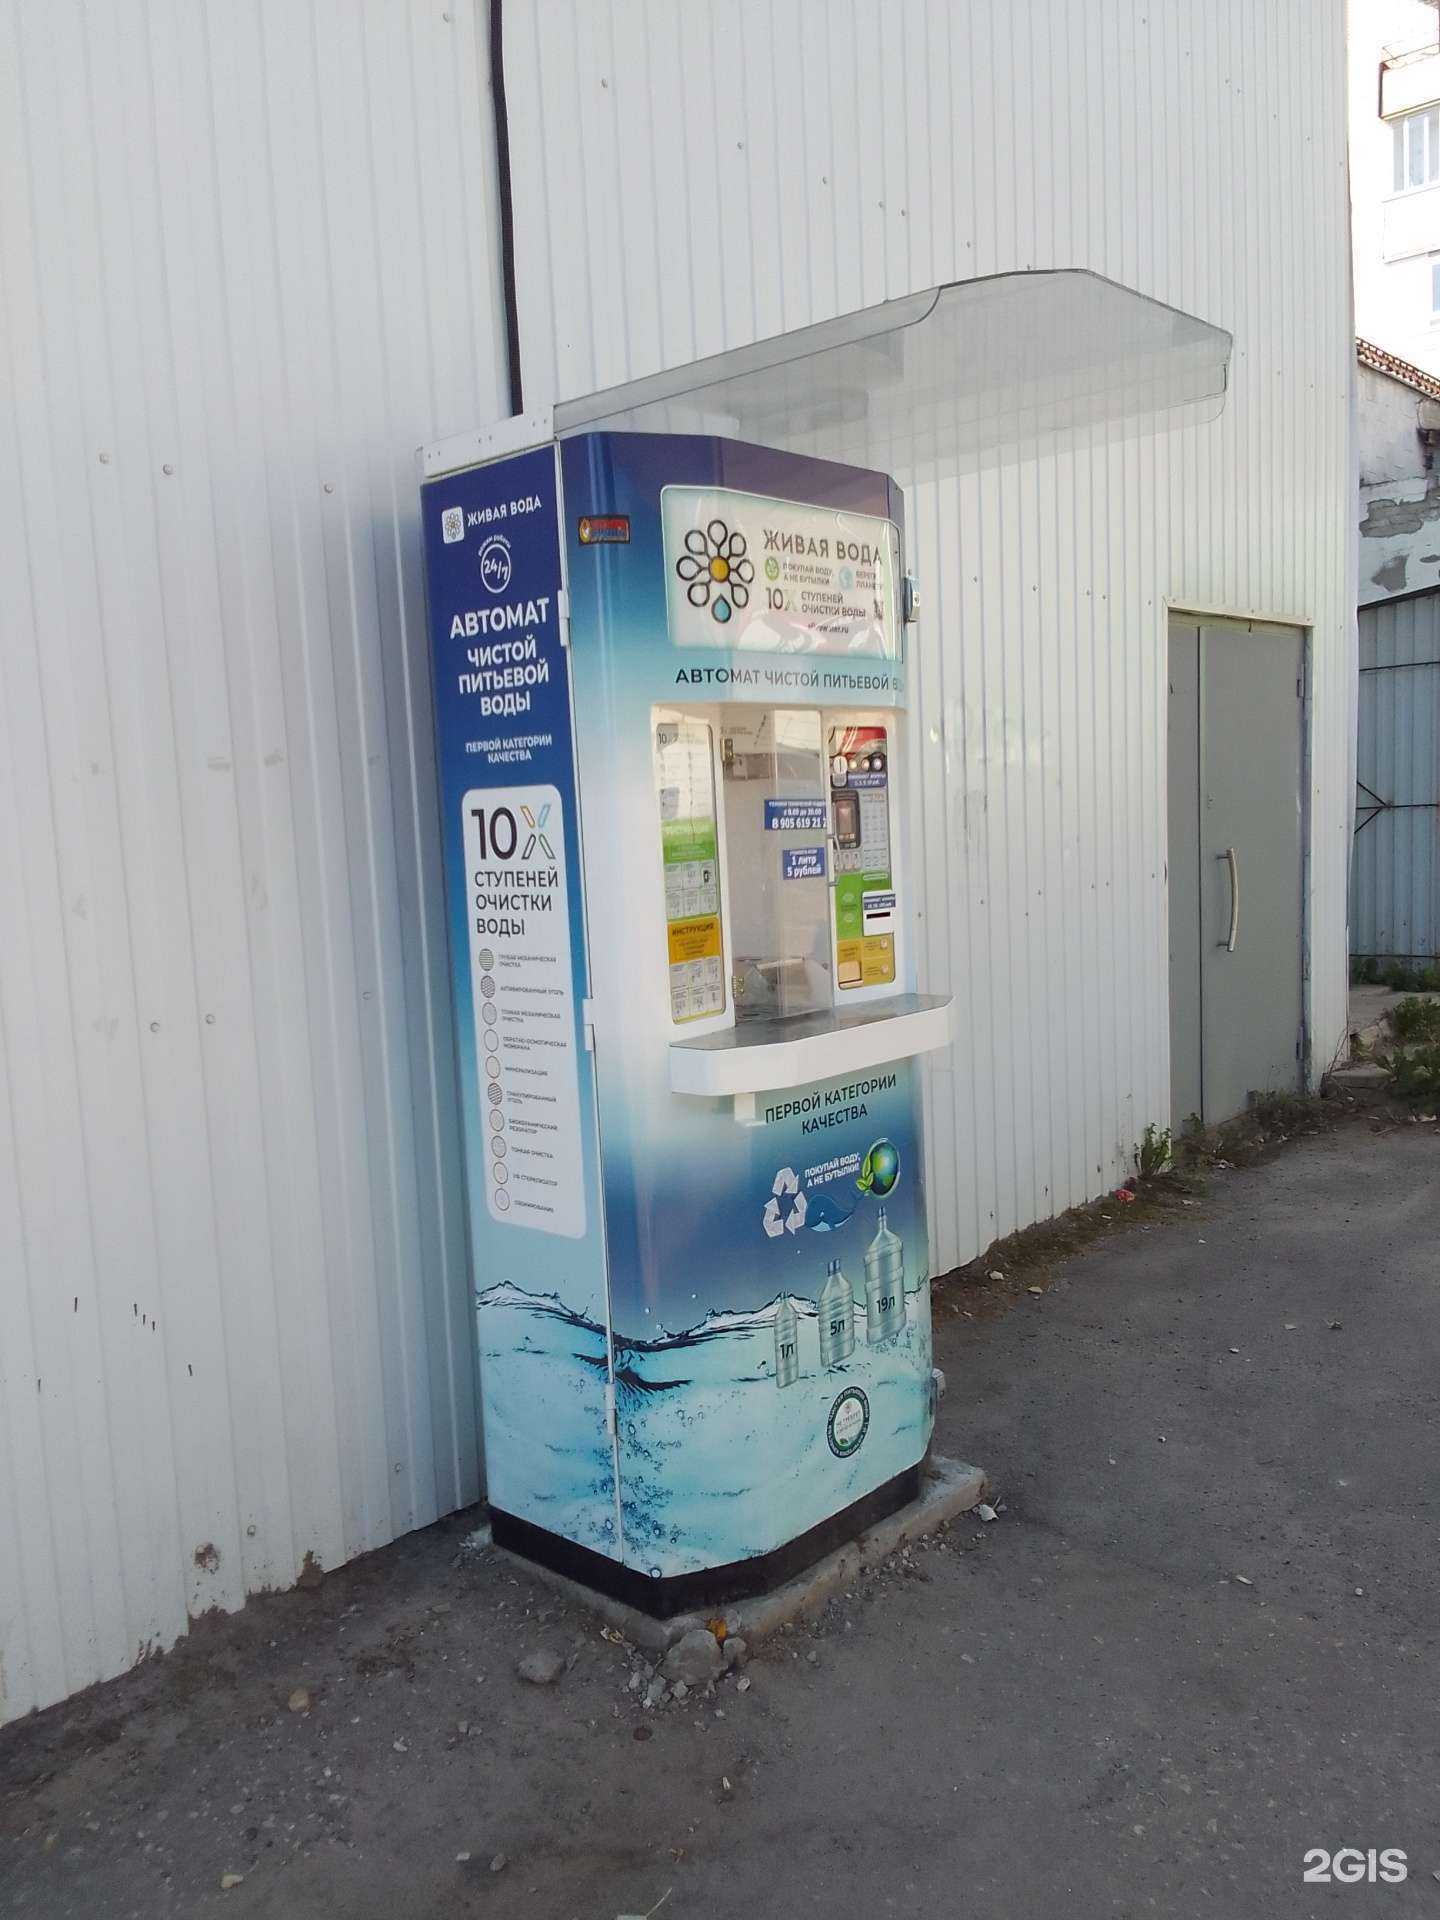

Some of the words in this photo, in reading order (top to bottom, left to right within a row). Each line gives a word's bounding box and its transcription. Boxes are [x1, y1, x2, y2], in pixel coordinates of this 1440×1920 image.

[467, 504, 507, 527] ЖИВАЯ
[510, 495, 541, 516] ВОДА
[763, 529, 829, 558] ЖИВАЯ
[836, 541, 883, 566] ВОДА
[484, 558, 509, 580] 24/7
[801, 591, 844, 603] СТУПЕНЕЙ
[450, 597, 550, 640] АВТОМАТ
[801, 604, 840, 616] ОЧИСТКИ
[841, 607, 866, 619] ВОДЫ
[467, 634, 537, 668] ЧИСТОЙ
[458, 658, 549, 694] ПИТЬЕВОЙ
[675, 668, 760, 685] АВТОМАТ
[764, 669, 819, 688] ЧИСТОЙ
[823, 673, 889, 691] ПИТЬЕВОЙ
[480, 690, 531, 717] ВОДЫ
[466, 738, 501, 752] ПЕРВОЙ
[502, 734, 552, 750] КАТЕГОРИИ
[487, 750, 532, 764] КАЧЕСТВА
[780, 818, 795, 829] 905
[796, 818, 811, 829] 619
[812, 817, 821, 828] 21
[792, 856, 796, 866] 1
[474, 866, 558, 888] СТУПЕНЕЙ
[787, 867, 793, 877] 5
[794, 864, 822, 879] рублей
[476, 894, 552, 911] ОЧИСТКИ
[477, 918, 525, 938] ВОДЫ
[765, 1091, 821, 1123] ПЕРВОЙ
[824, 1073, 897, 1106] КАТЕГОРИИ
[801, 1103, 868, 1135] КАЧЕСТВА
[804, 1157, 840, 1178] ПОКУПАЙ
[806, 1178, 814, 1188] А
[813, 1173, 824, 1185] НЕ
[876, 1296, 895, 1314] 19л
[830, 1320, 845, 1337] 5л
[779, 1343, 794, 1361] 1л
